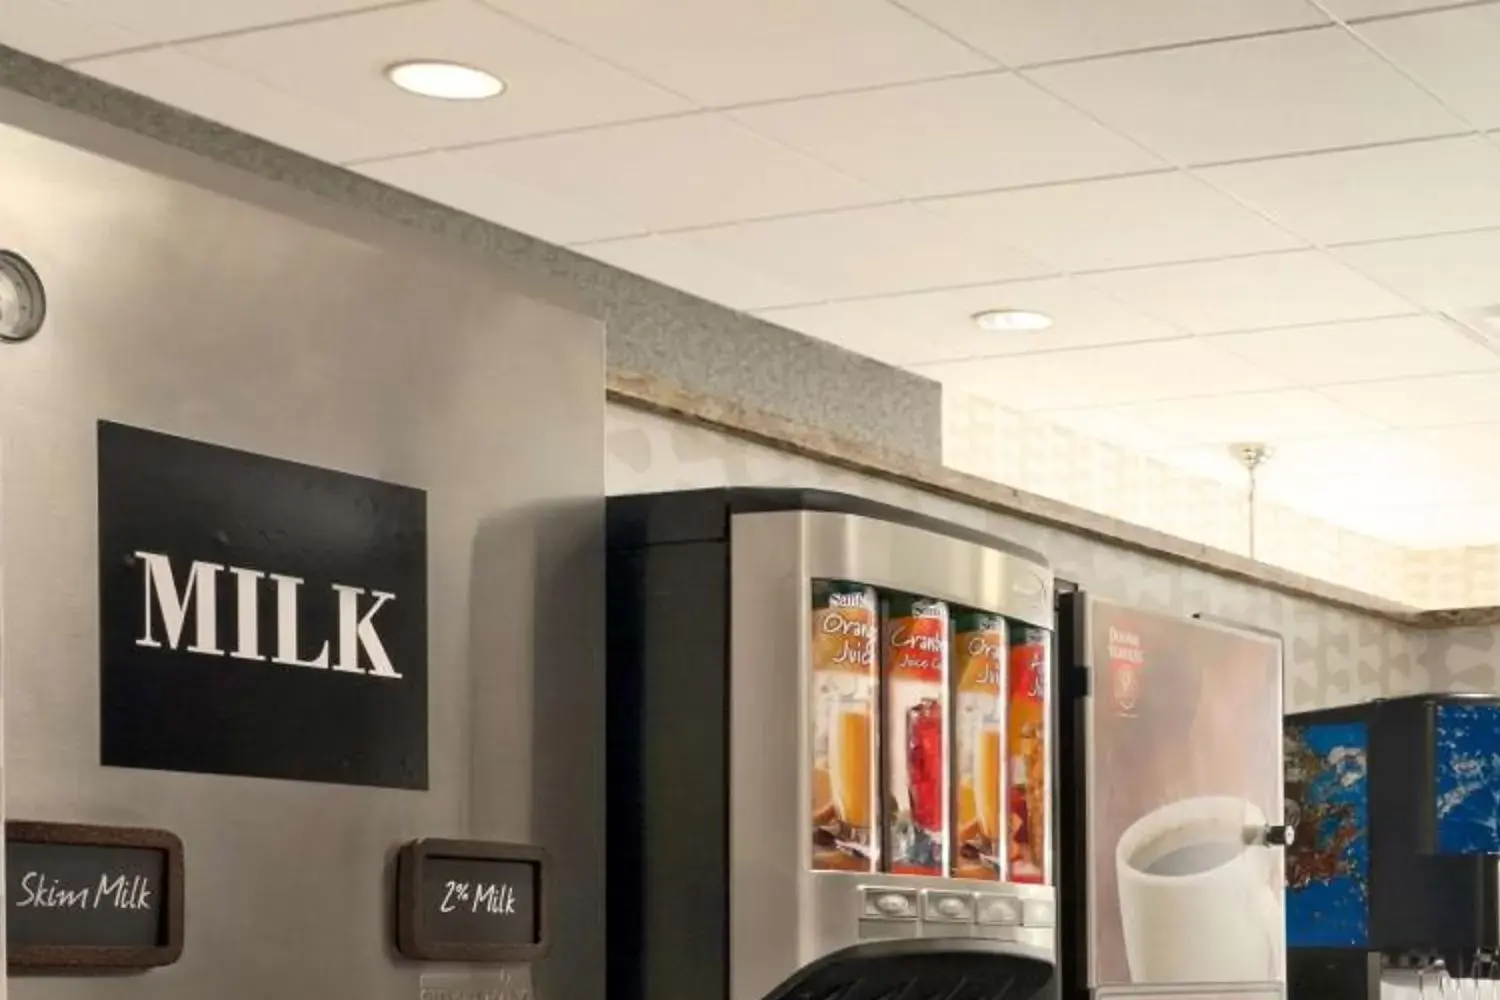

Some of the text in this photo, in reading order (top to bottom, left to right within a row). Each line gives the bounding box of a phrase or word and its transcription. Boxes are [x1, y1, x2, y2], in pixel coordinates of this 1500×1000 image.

[134, 550, 404, 679] MILK
[16, 871, 152, 910] Skim Milk
[440, 879, 516, 916] 2% Milk
